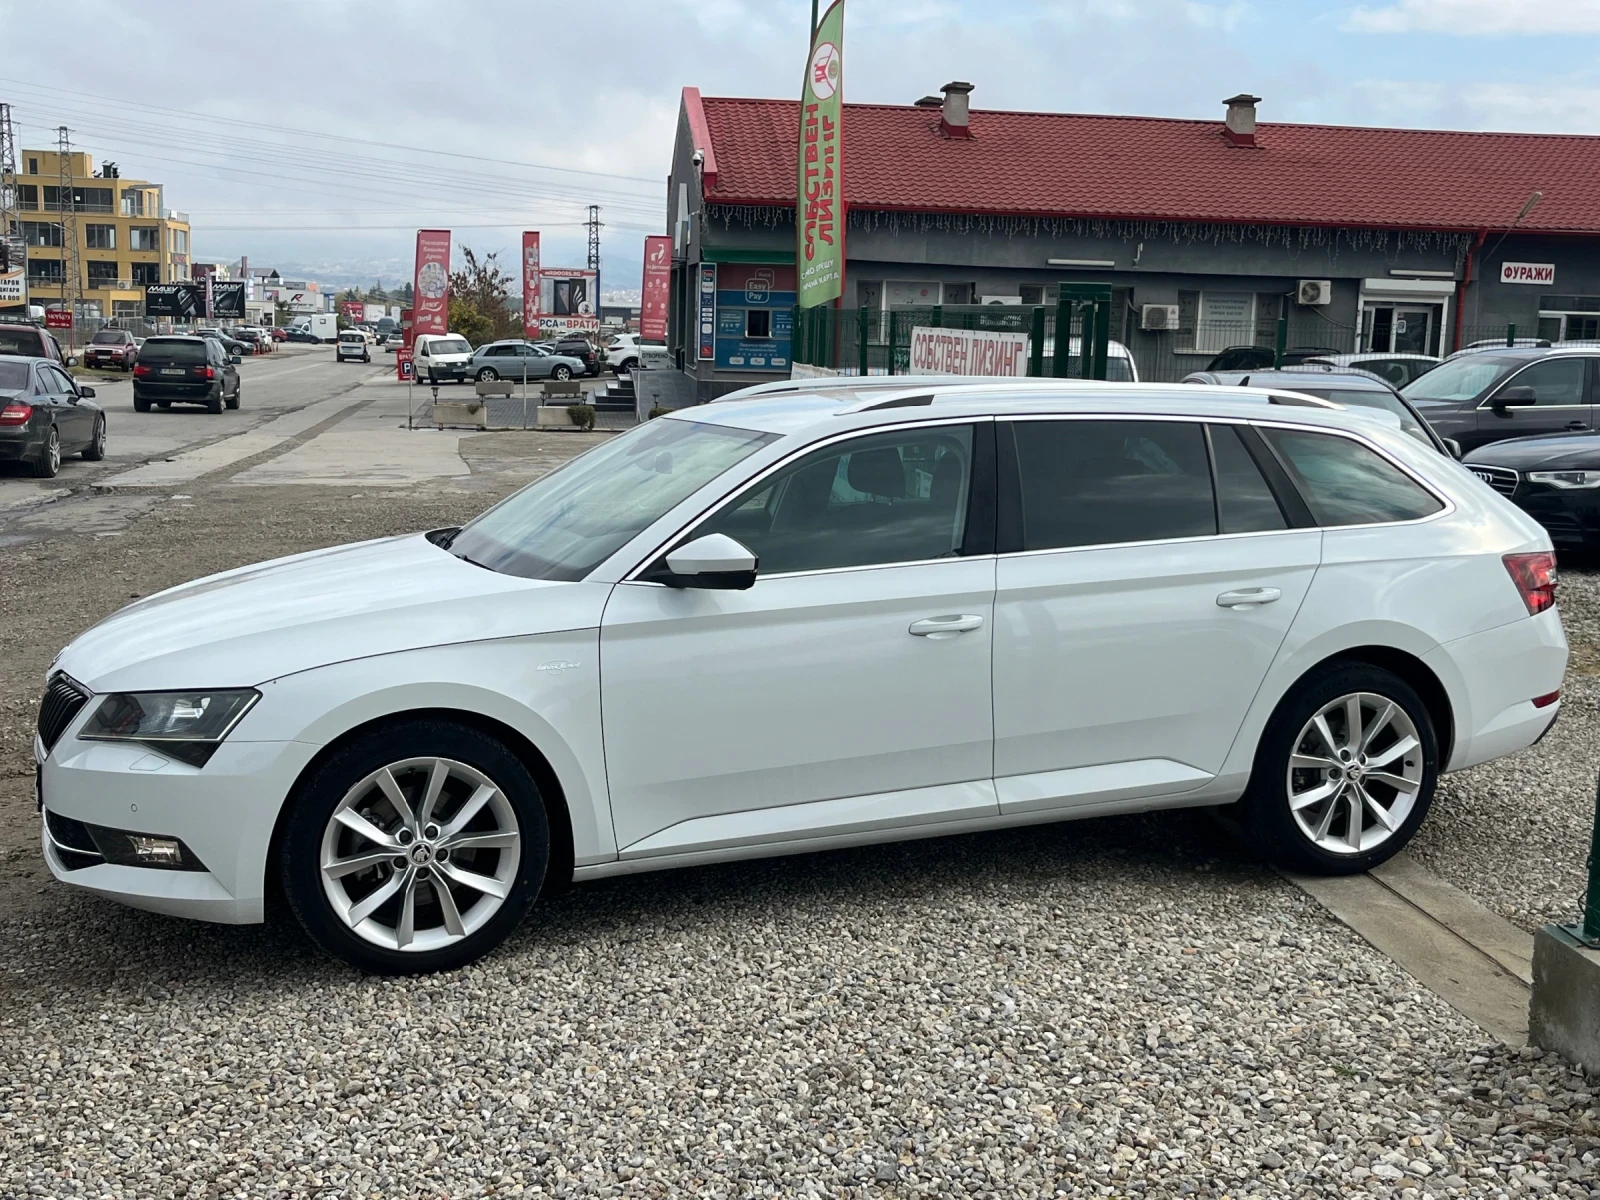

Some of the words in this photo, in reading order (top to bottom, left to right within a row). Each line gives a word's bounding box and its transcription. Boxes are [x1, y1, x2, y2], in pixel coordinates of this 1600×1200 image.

[1503, 266, 1553, 281] ФУРАЖИ
[749, 282, 766, 290] Easy
[749, 292, 762, 300] Pay
[540, 320, 559, 328] РСА
[566, 320, 599, 329] ВРАТИ
[642, 351, 668, 359] ОТВОРЕНО
[913, 332, 968, 375] СОБСТВЕН
[969, 338, 1023, 377] ЛИЗИНГ
[404, 363, 411, 374] P
